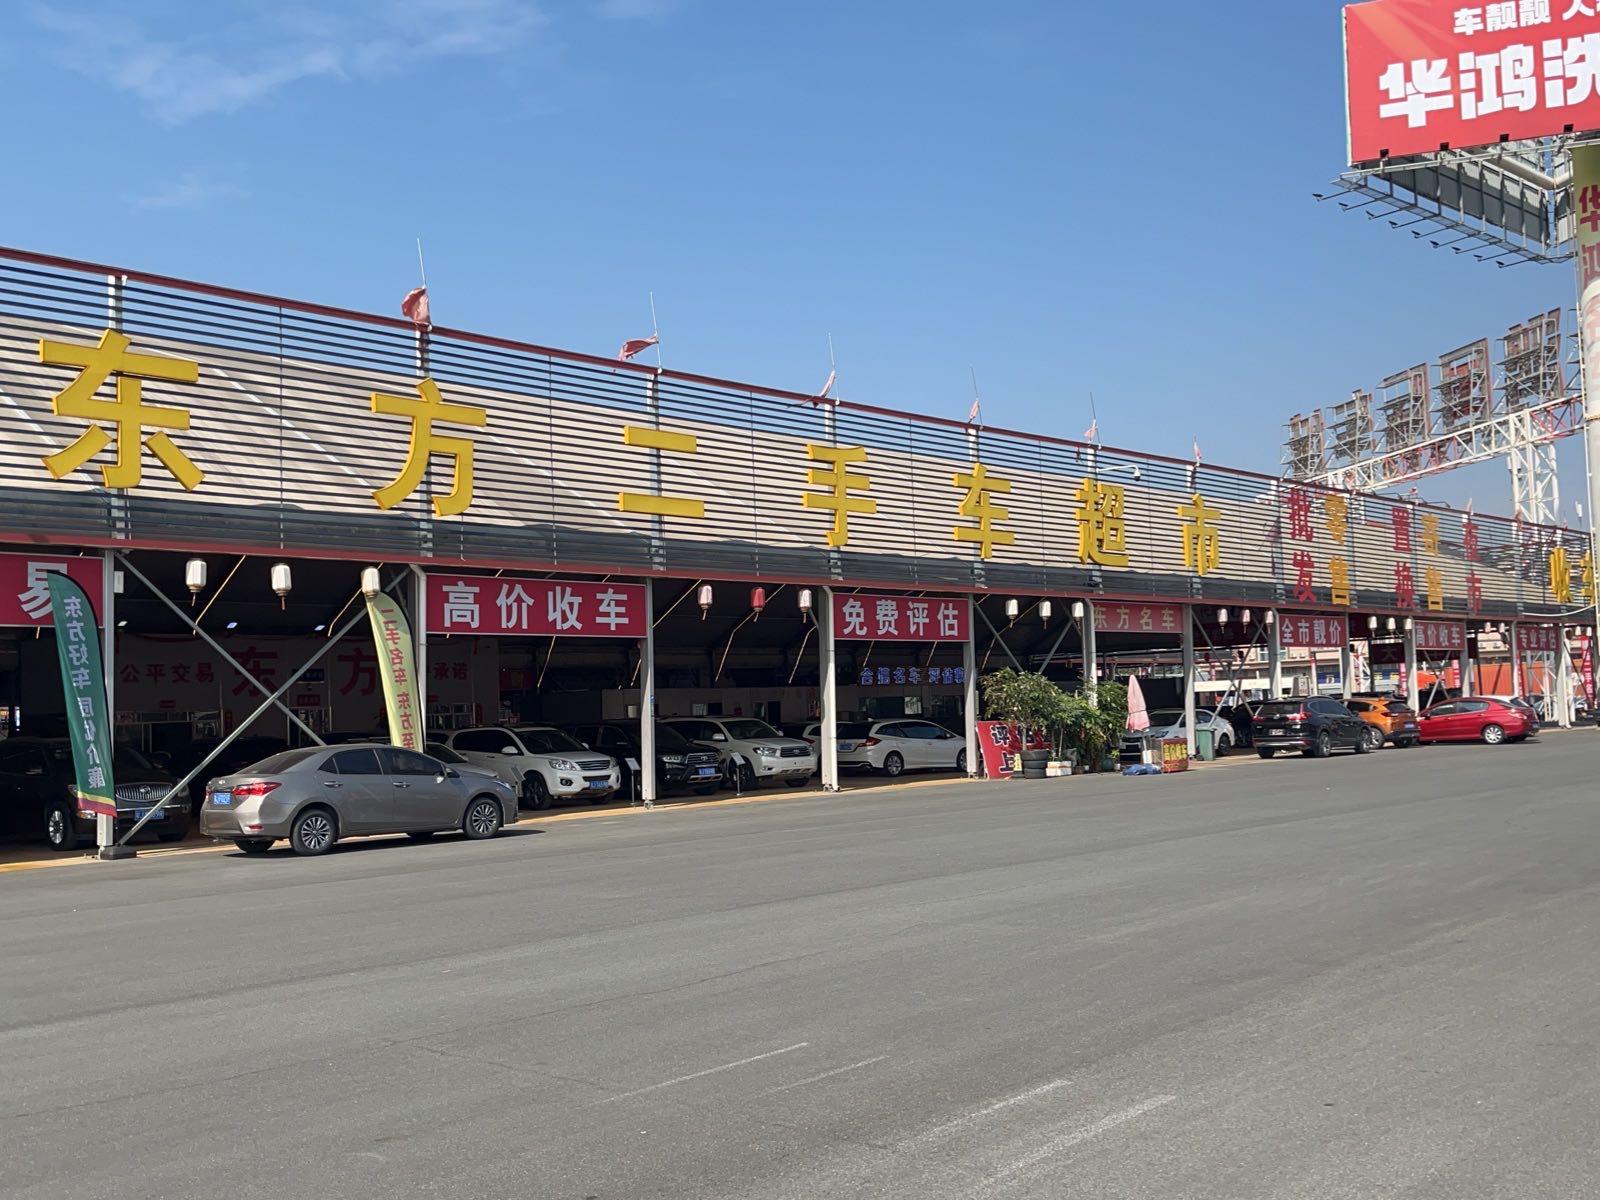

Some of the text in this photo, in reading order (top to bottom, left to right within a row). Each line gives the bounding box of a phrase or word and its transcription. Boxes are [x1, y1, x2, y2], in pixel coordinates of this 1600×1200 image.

[1453, 0, 1551, 36] 车靓靓
[1379, 32, 1600, 128] 华鸿洗
[38, 328, 1222, 577] 东方二手车超市
[442, 581, 629, 631] 高价收车
[842, 598, 959, 637] 免费评估
[1095, 606, 1175, 631] 东方名车
[1281, 618, 1342, 645] 全市靓价
[1415, 622, 1461, 646] 高价收车
[120, 662, 215, 684] 公平交易
